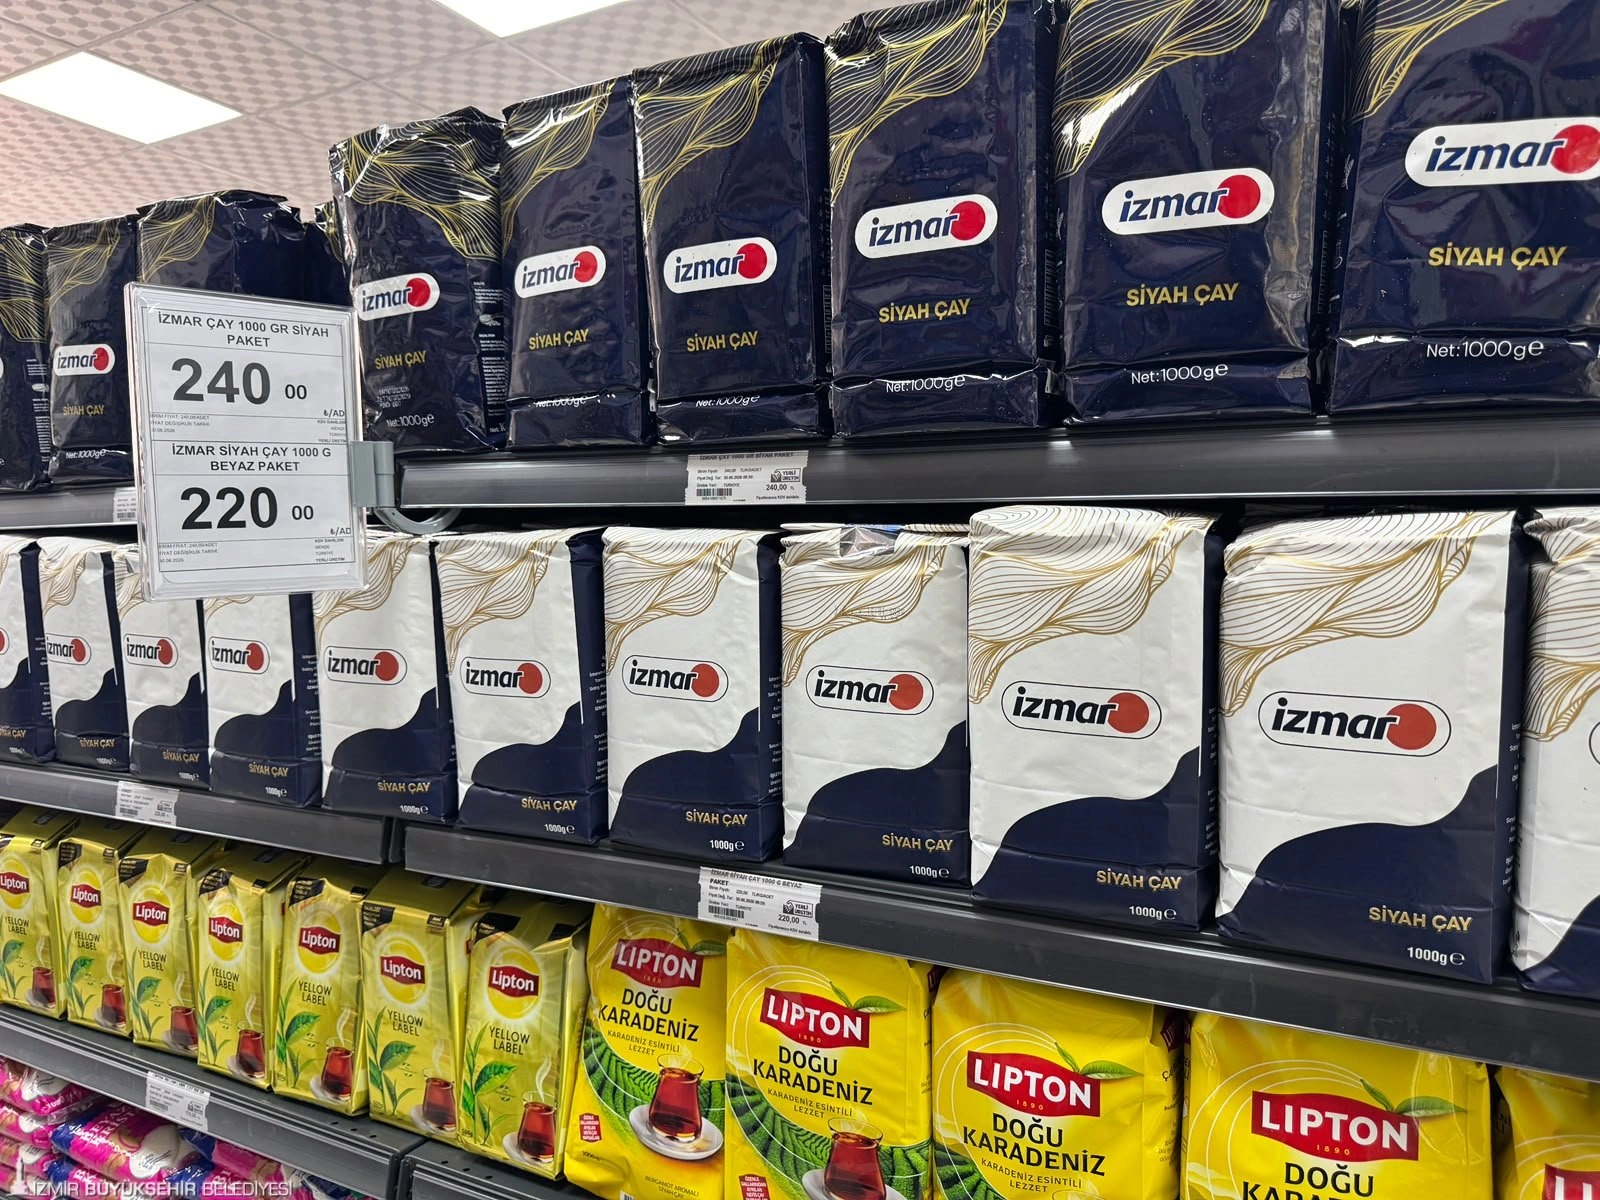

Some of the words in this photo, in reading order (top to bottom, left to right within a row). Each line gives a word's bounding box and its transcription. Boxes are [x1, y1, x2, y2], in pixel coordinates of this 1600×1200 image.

[1425, 135, 1565, 173] izmar
[1118, 186, 1228, 223] izmar
[869, 213, 958, 247] izmar
[1428, 241, 1503, 266] SİYAH
[1510, 245, 1567, 271] ÇAY
[521, 261, 579, 290] izmar
[674, 252, 744, 283] izmar
[362, 288, 411, 312] izmar
[1126, 283, 1188, 307] SİYAH
[1193, 282, 1240, 307] ÇAY
[878, 302, 930, 324] SİYAH
[934, 298, 971, 320] ÇAY
[158, 311, 202, 327] İZMAR
[206, 317, 234, 334] ÇAY
[238, 320, 266, 333] 1000
[270, 323, 288, 334] GR
[292, 323, 329, 338] SİYAH
[227, 334, 270, 347] PAKET
[528, 332, 562, 350] SİYAH
[563, 328, 590, 347] ÇAY
[686, 332, 726, 352] SİYAH
[729, 330, 759, 351] ÇAY
[57, 352, 97, 369] izmar
[375, 354, 402, 370] SİYAH
[405, 350, 427, 367] ÇAY
[171, 357, 271, 405] 240
[284, 384, 307, 400] 00
[62, 403, 84, 416] SİYAH
[86, 404, 105, 417] ÇAY
[172, 443, 216, 457] İZMAR
[219, 444, 258, 457] SİYAH
[262, 446, 288, 460] ÇAY
[292, 447, 318, 457] 1000
[323, 447, 331, 457] G
[210, 460, 255, 472] BEYAZ
[258, 461, 300, 472] PAKET
[766, 483, 787, 491] 240,00
[180, 486, 278, 530] 220
[291, 505, 314, 521] 00
[126, 636, 161, 659] izmar
[211, 640, 250, 665] izmar
[328, 649, 378, 676] izmar
[465, 661, 523, 688] izmar
[629, 659, 697, 690] izmar
[814, 670, 896, 704] izmar
[1012, 686, 1116, 725] izmar
[1272, 697, 1397, 740] izmar
[162, 749, 183, 761] SİYAH
[184, 752, 200, 763] ÇAY
[249, 763, 270, 775] SİYAH
[271, 766, 289, 777] ÇAY
[377, 780, 407, 792] SİYAH
[408, 782, 431, 794] ÇAY
[521, 796, 551, 811] SİYAH
[553, 800, 577, 812] ÇAY
[685, 809, 719, 825] SİYAH
[722, 813, 748, 828] ÇAY
[882, 832, 921, 850] SİYAH
[925, 837, 953, 854] ÇAY
[1096, 867, 1144, 889] SİYAH
[1148, 875, 1183, 892] ÇAY
[72, 888, 99, 904] Lipton
[136, 905, 167, 922] Lipton
[778, 914, 800, 924] 220,00
[1368, 905, 1426, 927] SİYAH
[1432, 914, 1473, 932] ÇAY
[74, 930, 100, 943] YELLOW
[210, 920, 240, 938] Lipton
[77, 939, 98, 951] LABEL
[301, 932, 337, 950] Lipton
[139, 950, 167, 962] YELLOW
[143, 959, 164, 972] LABEL
[616, 942, 697, 982] LIPTON
[211, 967, 239, 981] YELLOW
[383, 959, 422, 981] Lipton
[492, 969, 535, 992] Lipton
[215, 979, 236, 992] LABEL
[298, 980, 332, 996] YELLOW
[302, 992, 327, 1006] LABEL
[621, 988, 672, 1015] DOĞU
[388, 1009, 423, 1027] YELLOW
[392, 1021, 420, 1037] LABEL
[598, 1004, 700, 1042] KARADENİZ
[766, 995, 863, 1041] LIPTON
[489, 1026, 530, 1045] YELLOW
[607, 1029, 647, 1046] KARADENİZ
[648, 1039, 680, 1053] ESİNTİLİ
[798, 1033, 822, 1043] 1890
[493, 1038, 524, 1056] LABEL
[628, 1044, 655, 1056] LEZZET
[779, 1045, 838, 1077] DOĞU
[753, 1057, 873, 1106] KARADENİZ
[973, 1058, 1091, 1110] LIPTON
[767, 1087, 813, 1107] KARADENİZ
[815, 1099, 853, 1117] ESİNTİLİ
[793, 1104, 825, 1119] LEZZET
[1016, 1099, 1044, 1111] 1890
[993, 1113, 1063, 1148] DOĞU
[1261, 1099, 1408, 1152] LIPTON
[963, 1126, 1106, 1177] KARADENİZ
[1316, 1144, 1351, 1155] 1890
[981, 1158, 1034, 1182] KARADENİZ
[1037, 1174, 1083, 1189] ESİNTİLİ
[1285, 1162, 1374, 1198] DOĞU
[1009, 1179, 1048, 1193] LEZZET
